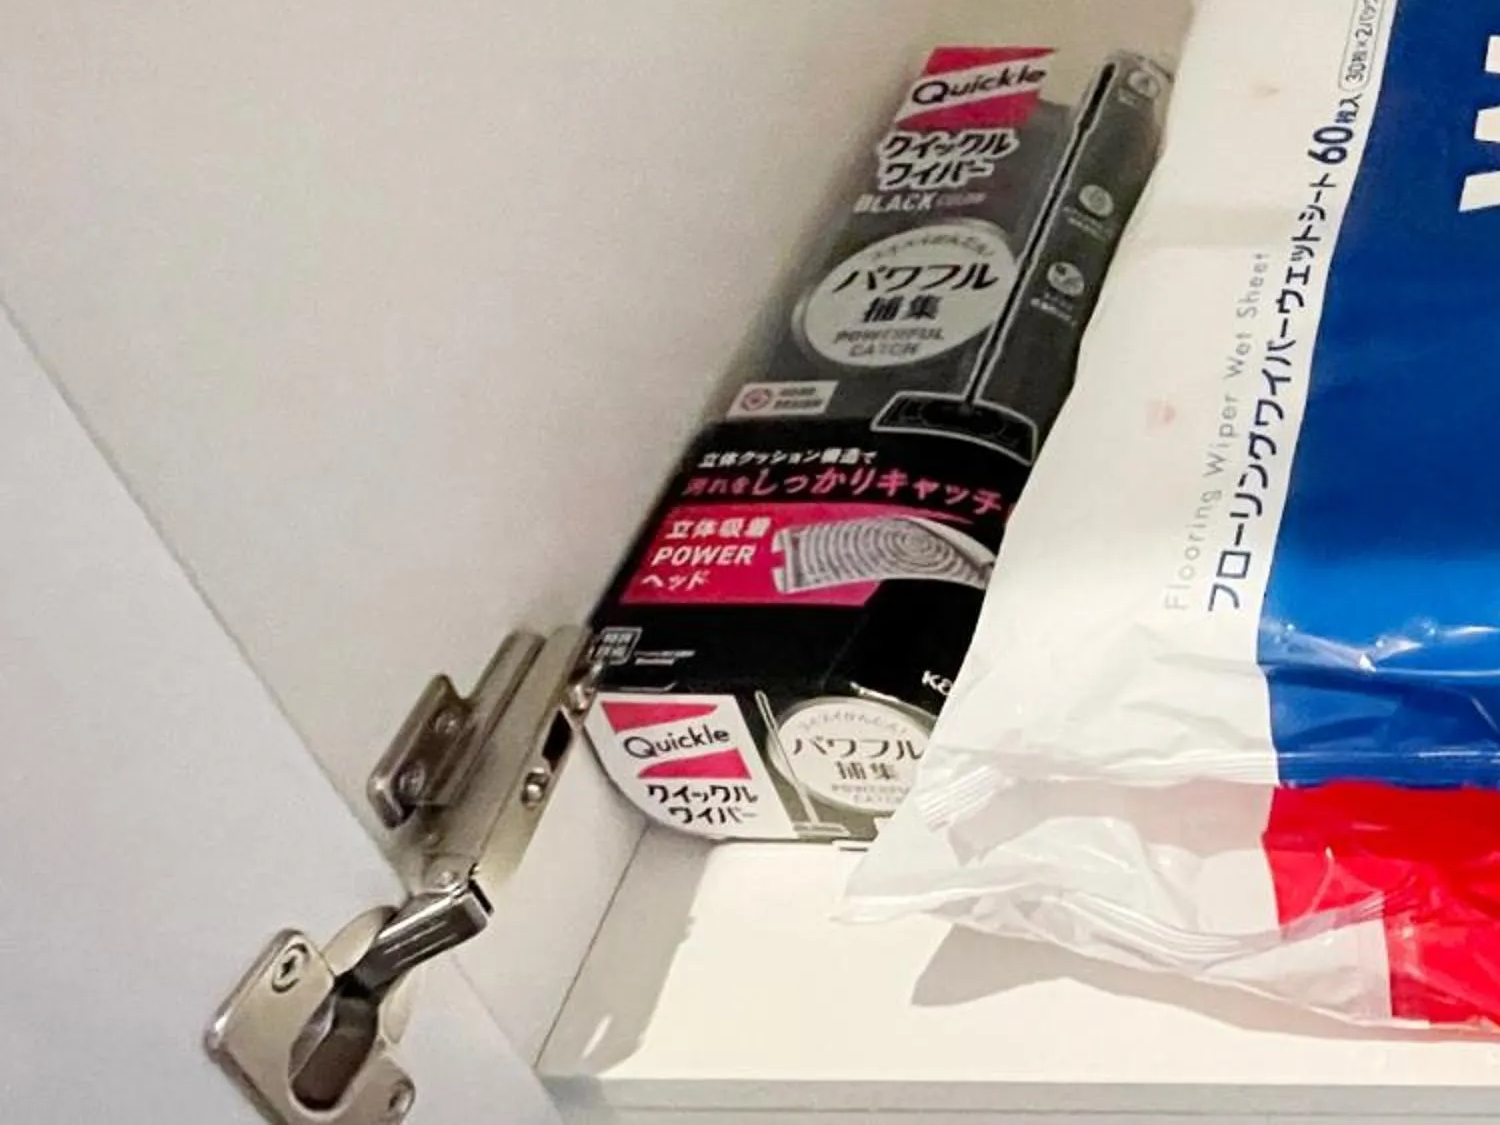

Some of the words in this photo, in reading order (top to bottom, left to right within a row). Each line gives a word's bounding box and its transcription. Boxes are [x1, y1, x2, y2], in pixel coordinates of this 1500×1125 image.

[912, 65, 1047, 105] Quickle
[883, 132, 1012, 159] クイックル
[885, 160, 988, 186] ワイパー
[853, 191, 937, 214] BLACK
[831, 262, 999, 293] パワフル
[1236, 251, 1272, 319] Sheet
[1224, 332, 1253, 380] Wet
[1202, 393, 1239, 478] Wiper
[651, 543, 758, 567] POWER
[1165, 489, 1222, 611] Flooring
[640, 569, 711, 592] ヘッド
[921, 669, 954, 697] Ka
[623, 723, 731, 759] Quickle
[646, 783, 760, 804] クイックル
[668, 805, 758, 824] ワイパー
